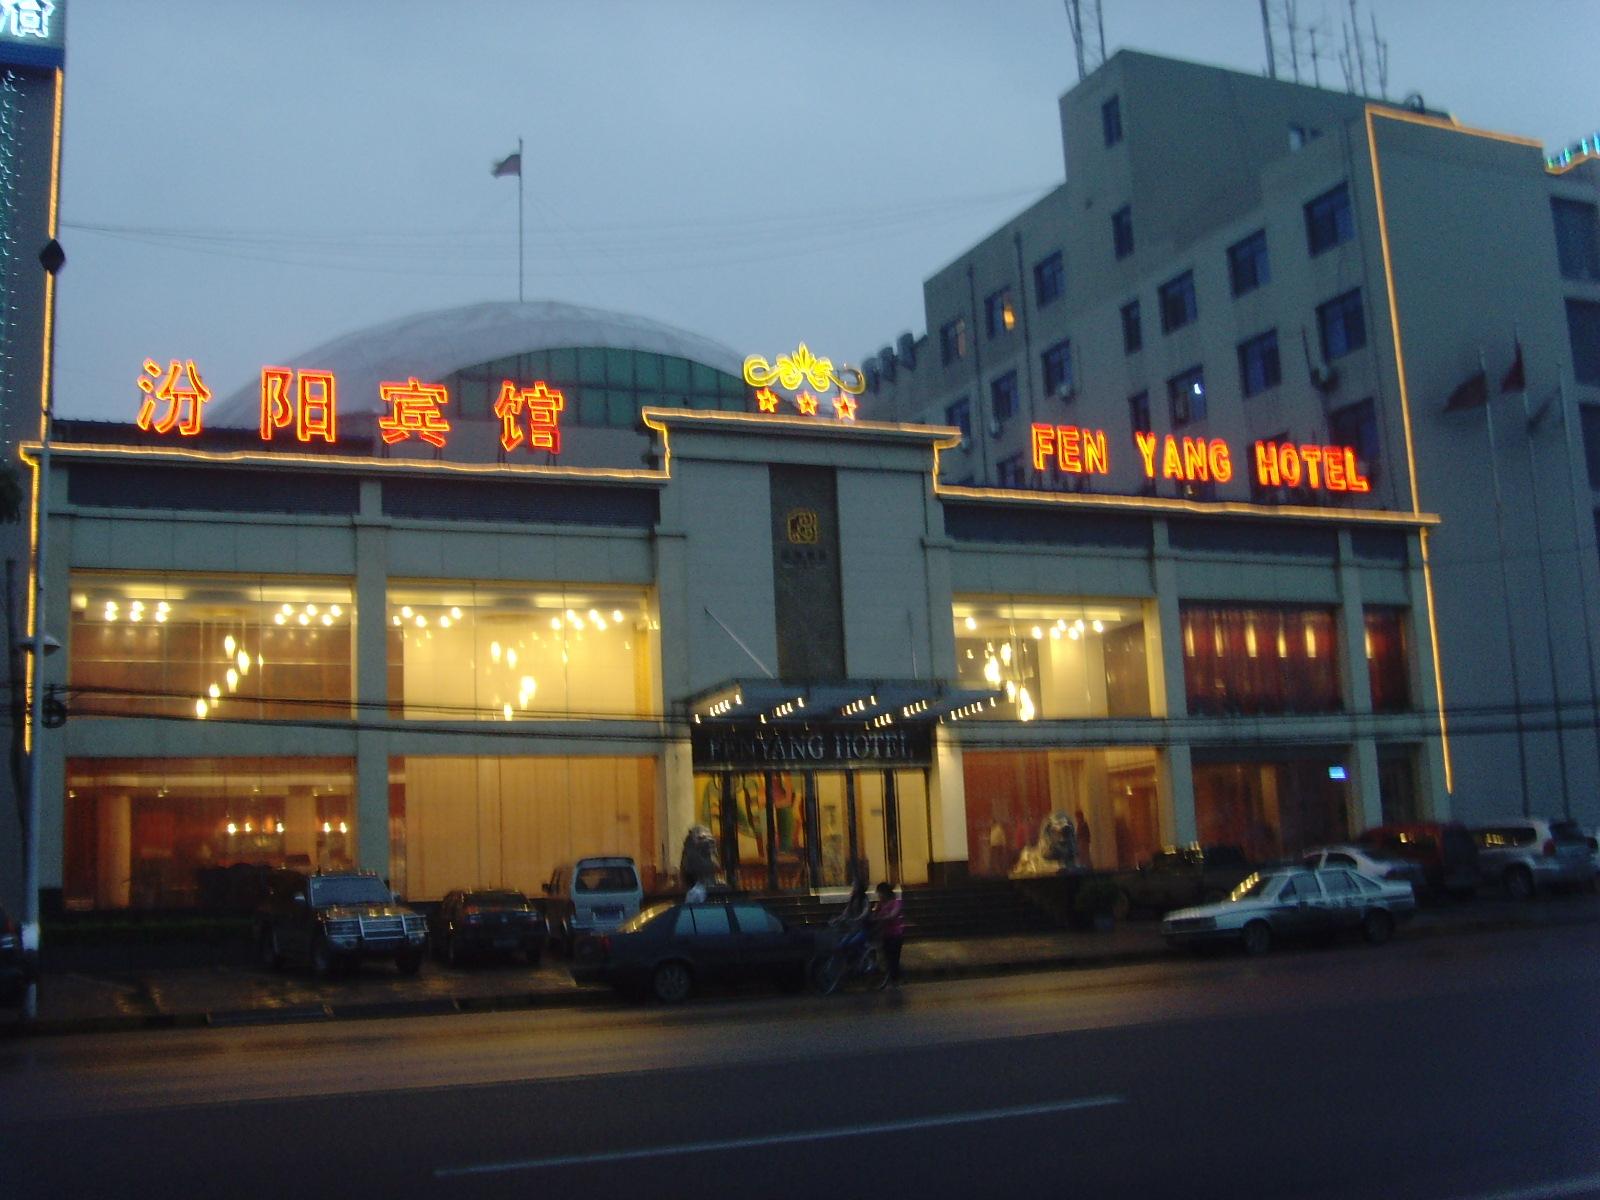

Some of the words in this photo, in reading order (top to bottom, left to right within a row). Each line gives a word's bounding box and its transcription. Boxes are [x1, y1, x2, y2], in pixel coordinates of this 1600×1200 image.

[136, 357, 565, 455] 汾阳宾馆
[1031, 423, 1108, 475] FEN
[1135, 431, 1232, 484] YANG
[1254, 440, 1371, 493] HOTEL
[835, 732, 914, 760] HOTEL
